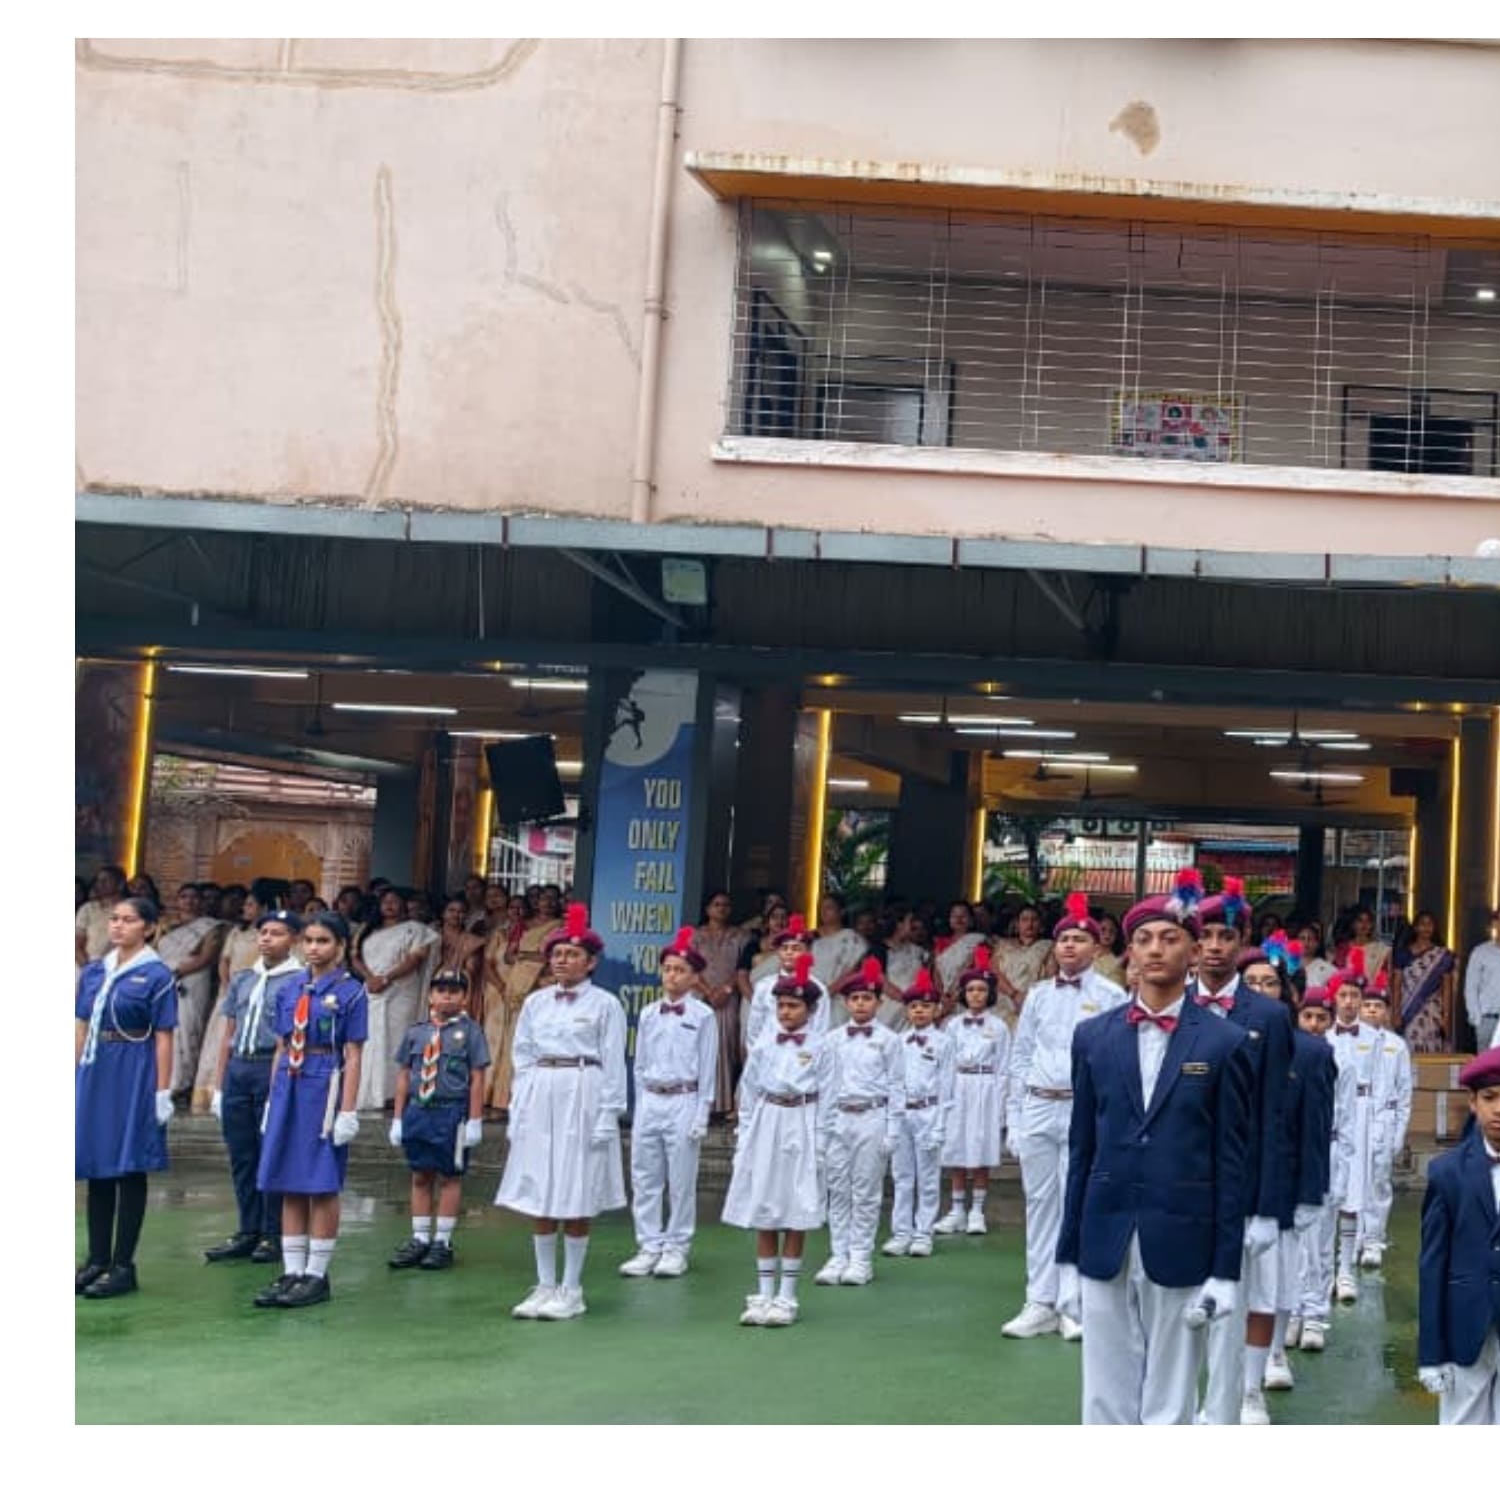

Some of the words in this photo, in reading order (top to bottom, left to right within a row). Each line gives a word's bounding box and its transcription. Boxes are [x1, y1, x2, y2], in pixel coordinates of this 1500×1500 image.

[644, 778, 681, 809] YOU
[629, 819, 680, 849] ONLY
[635, 861, 676, 892] FAIL
[611, 901, 673, 932] WHEN
[632, 945, 662, 977] YO
